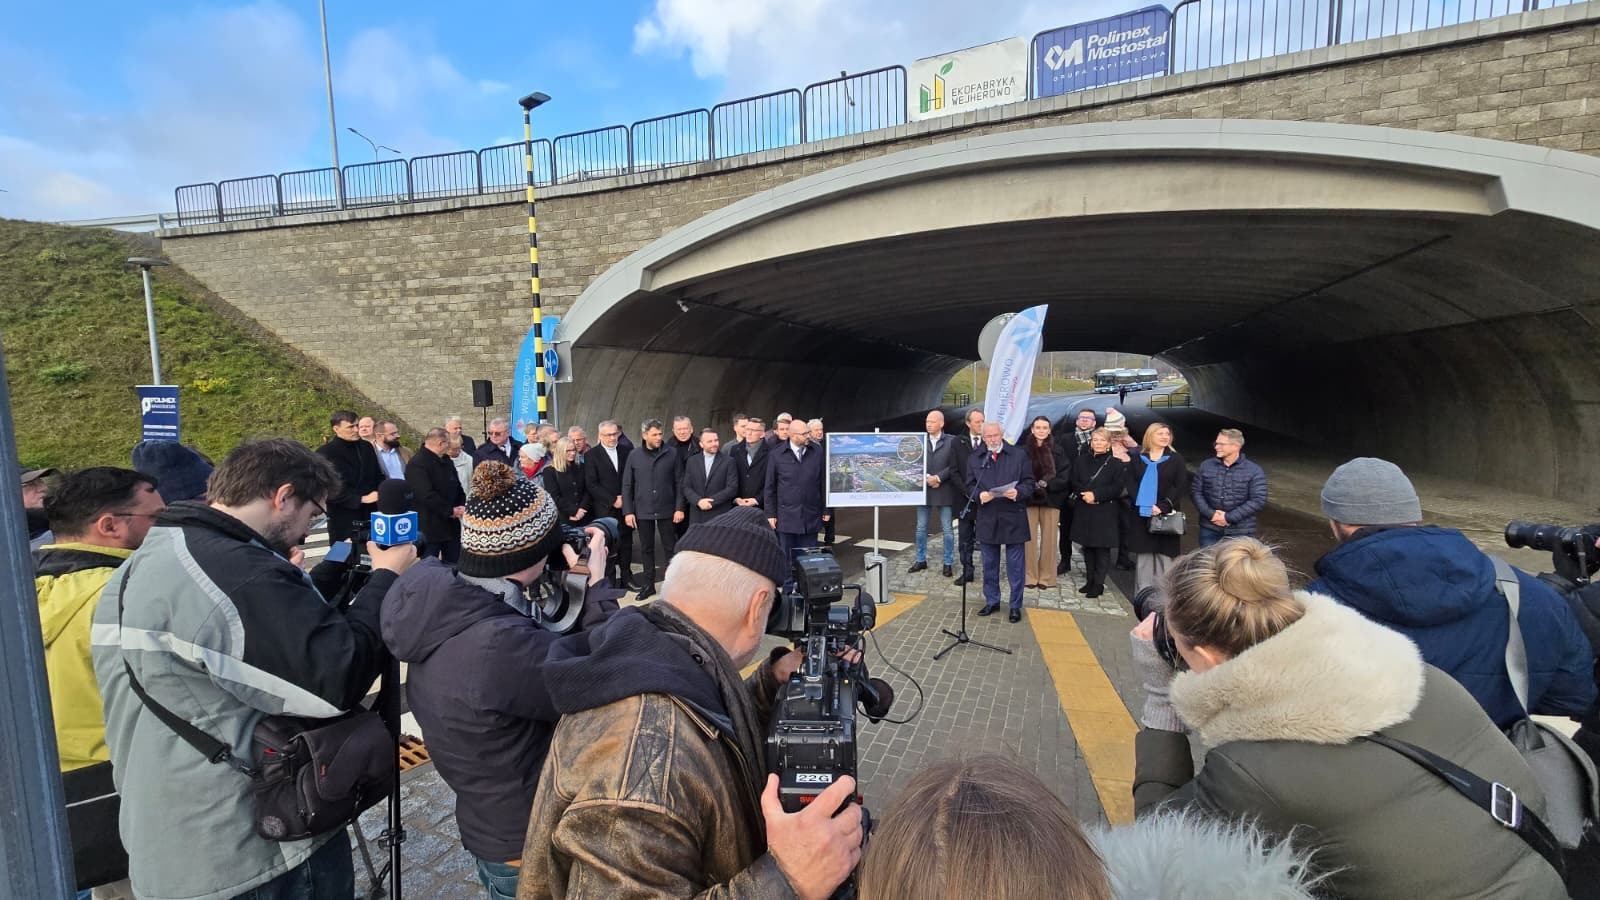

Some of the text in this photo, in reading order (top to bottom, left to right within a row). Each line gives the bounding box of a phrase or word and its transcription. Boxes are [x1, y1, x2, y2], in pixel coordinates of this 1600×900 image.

[1087, 25, 1151, 49] Polimex
[1087, 30, 1168, 61] Mostostal
[1053, 69, 1087, 81] GRUPA
[951, 76, 1016, 97] EKOFABRYKA
[951, 86, 1011, 105] WEJHEROWO
[799, 774, 829, 782] 22G
